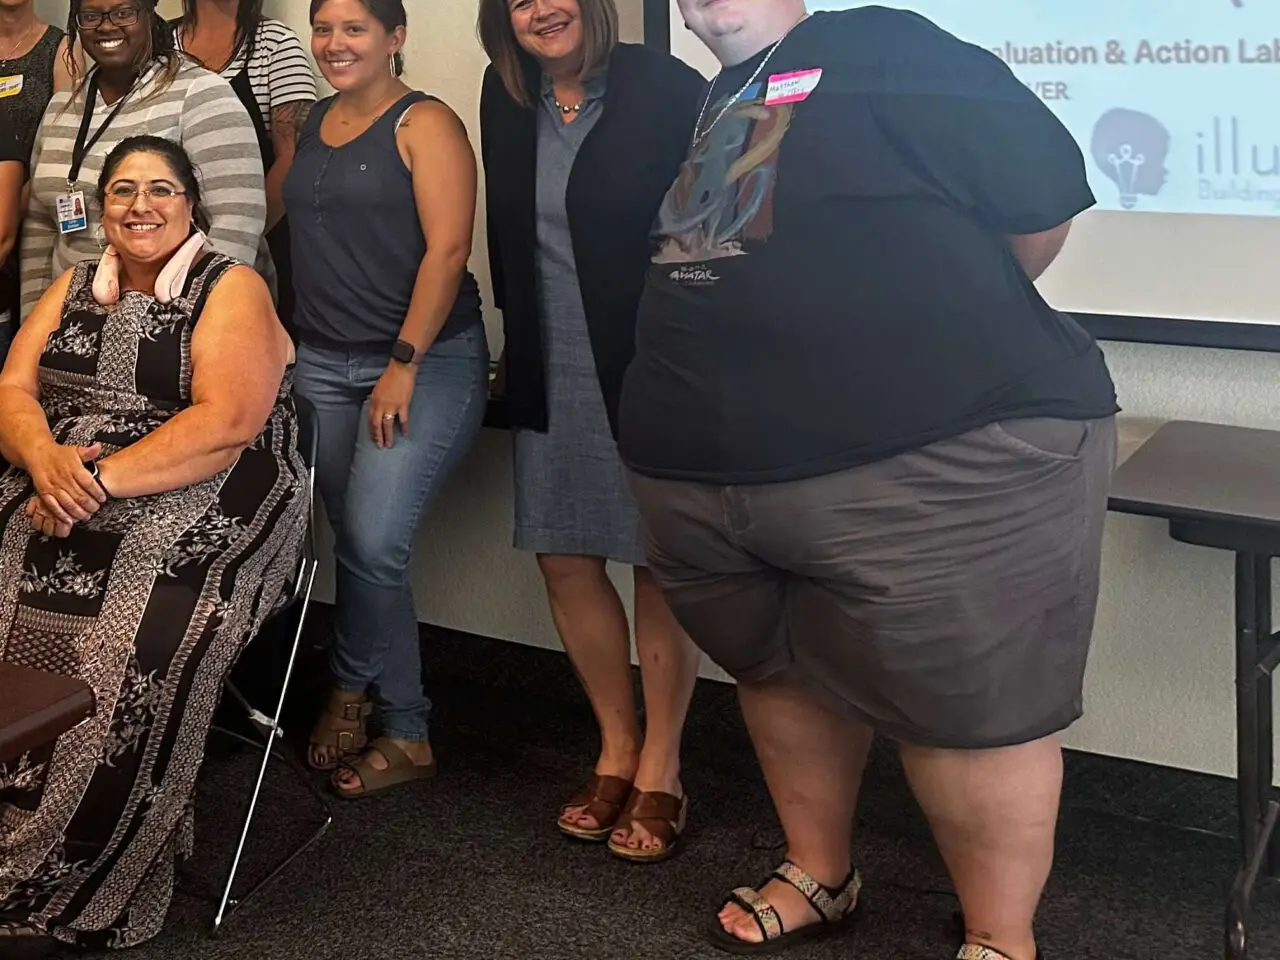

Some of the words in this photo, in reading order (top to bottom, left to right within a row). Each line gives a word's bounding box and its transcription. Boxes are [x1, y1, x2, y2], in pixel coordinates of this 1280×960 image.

[1105, 39, 1126, 64] &
[1134, 39, 1229, 64] Action
[1196, 115, 1280, 176] illu
